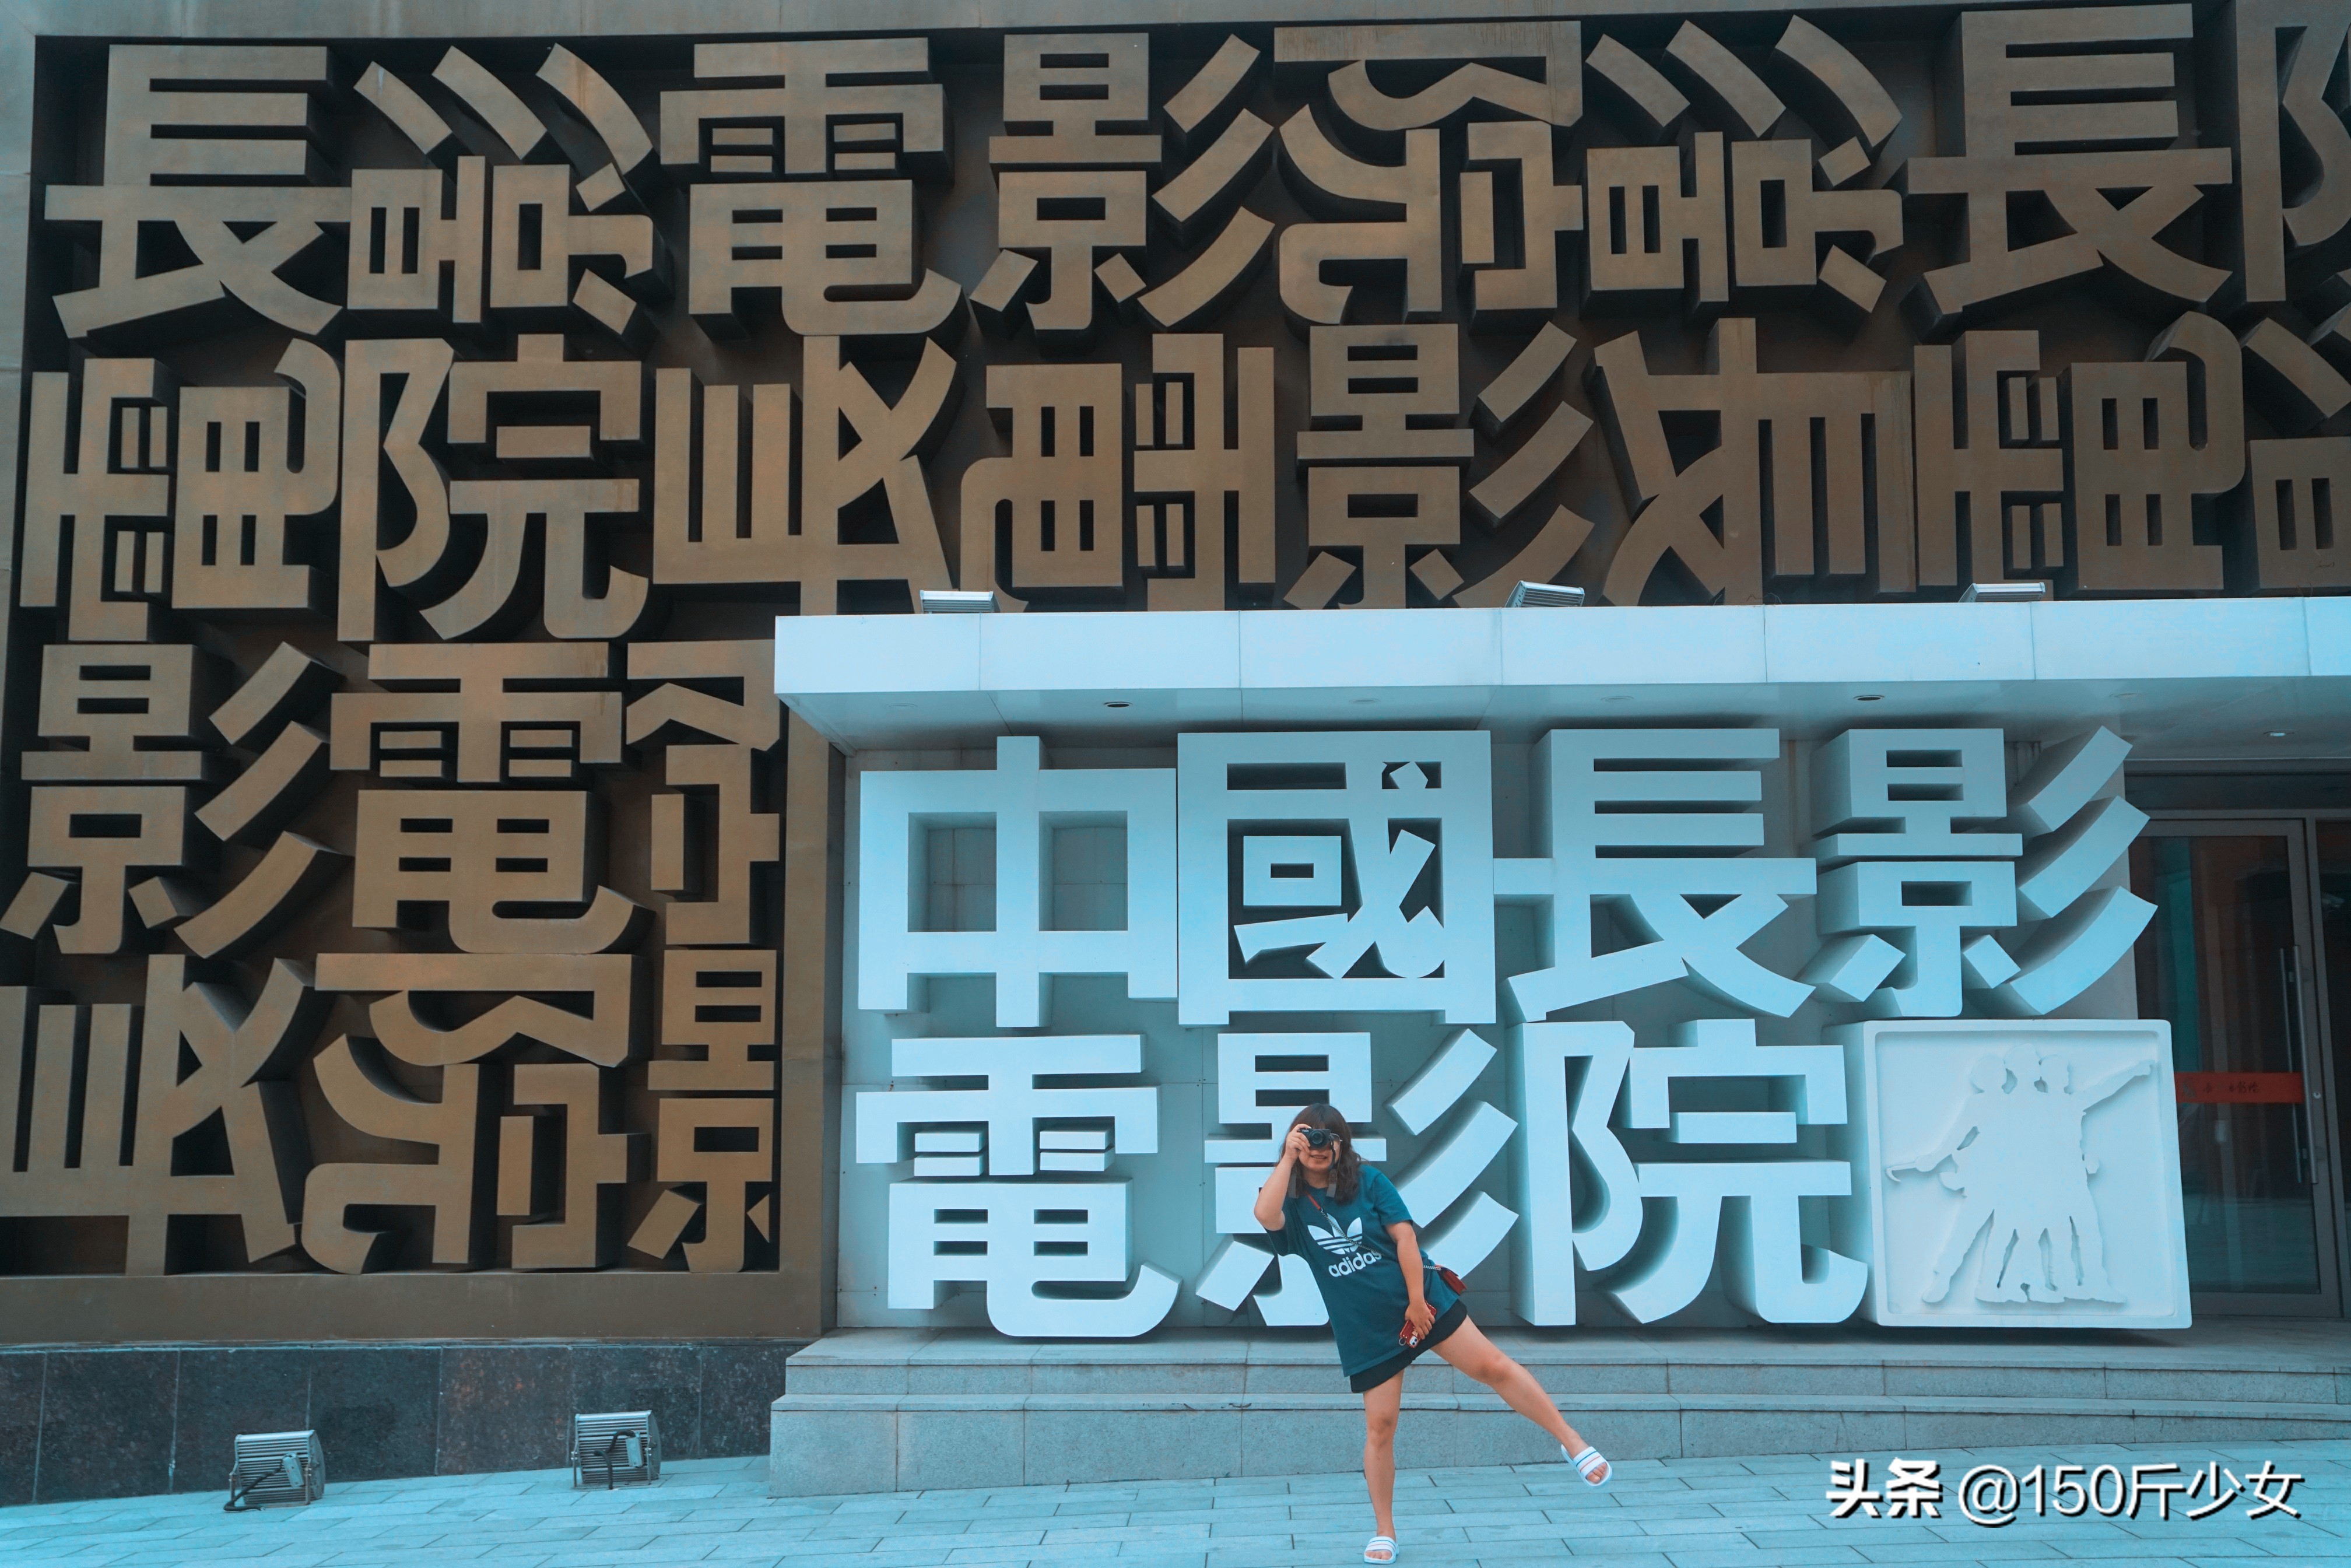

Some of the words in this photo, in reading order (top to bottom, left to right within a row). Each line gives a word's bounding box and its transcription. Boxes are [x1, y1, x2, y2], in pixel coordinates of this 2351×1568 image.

[858, 725, 2158, 1027] 中國長影
[855, 1018, 1868, 1337] 電影院
[1328, 1250, 1382, 1277] adidas
